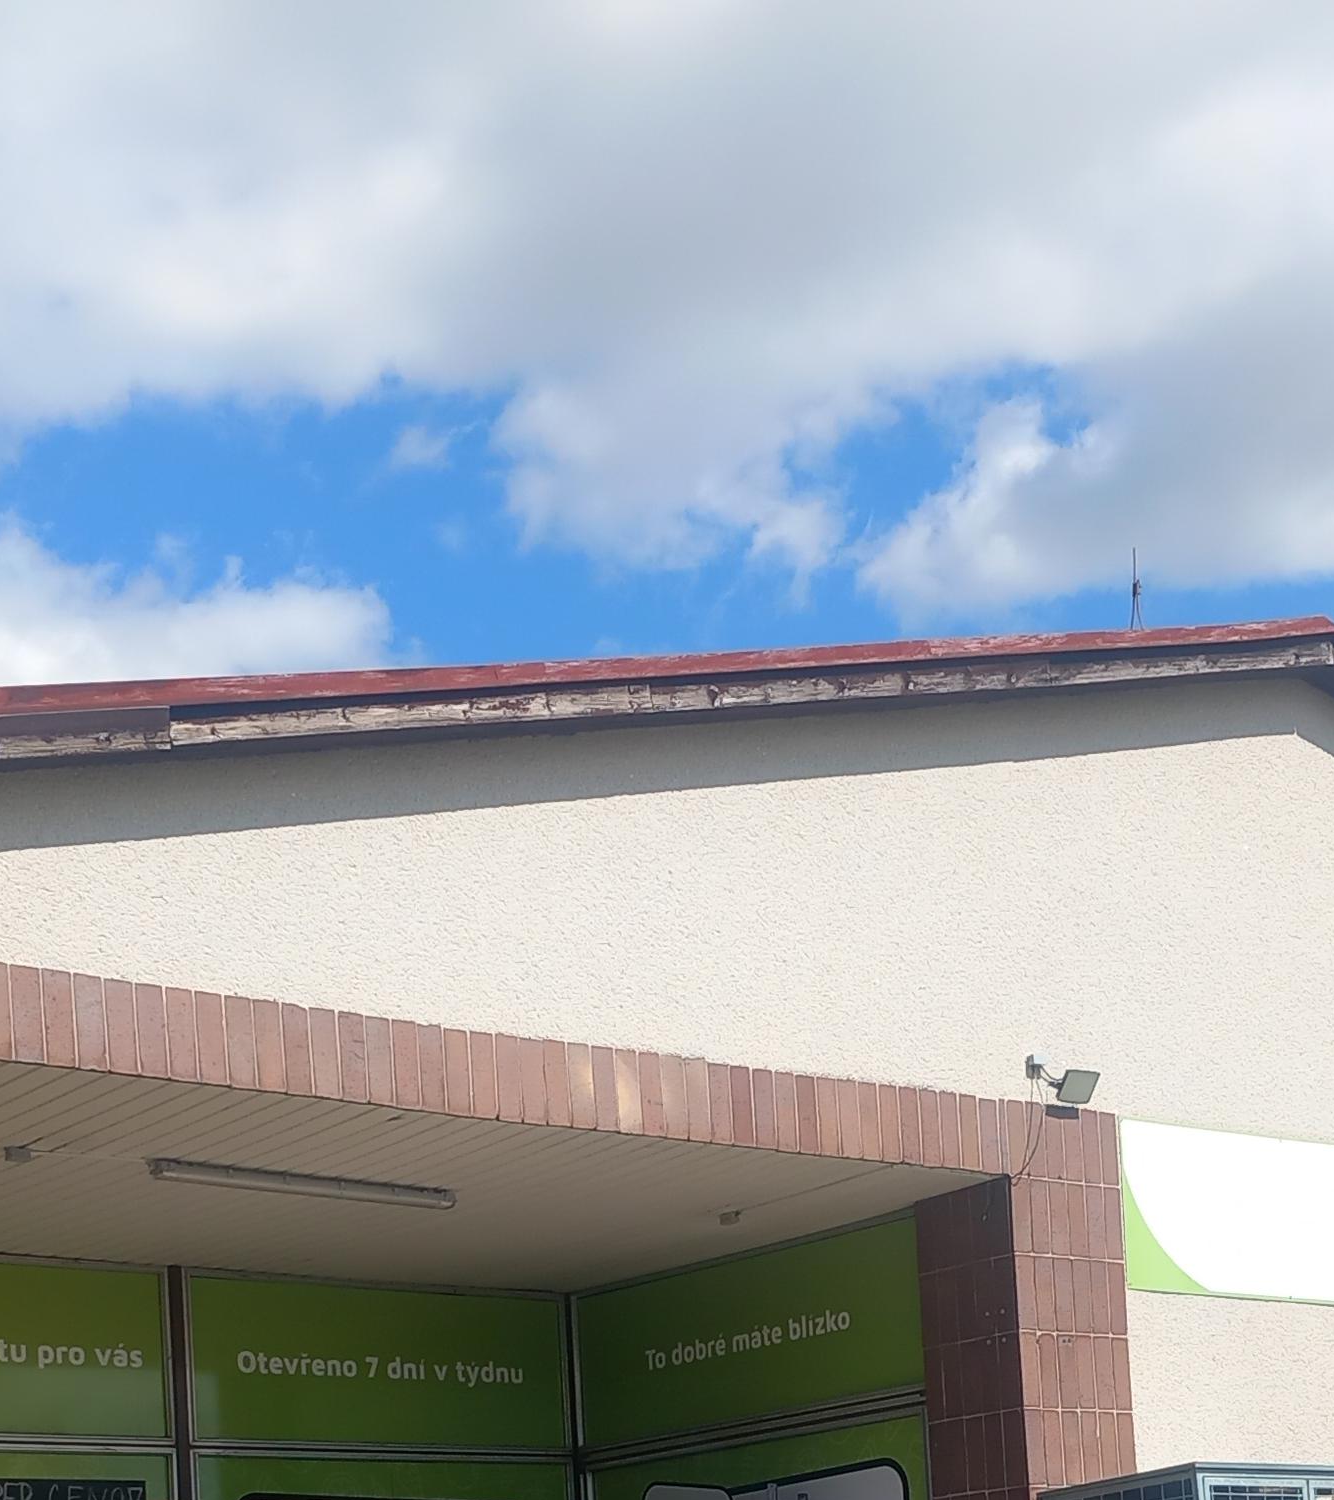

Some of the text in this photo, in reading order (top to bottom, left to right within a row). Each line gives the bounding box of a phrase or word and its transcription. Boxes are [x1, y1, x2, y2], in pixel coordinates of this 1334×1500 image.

[37, 1344, 85, 1370] pro
[94, 1343, 144, 1369] vás
[645, 1308, 851, 1373] To dobré máte blízko
[236, 1349, 524, 1388] Otevřeno 7 dní v týdnu
